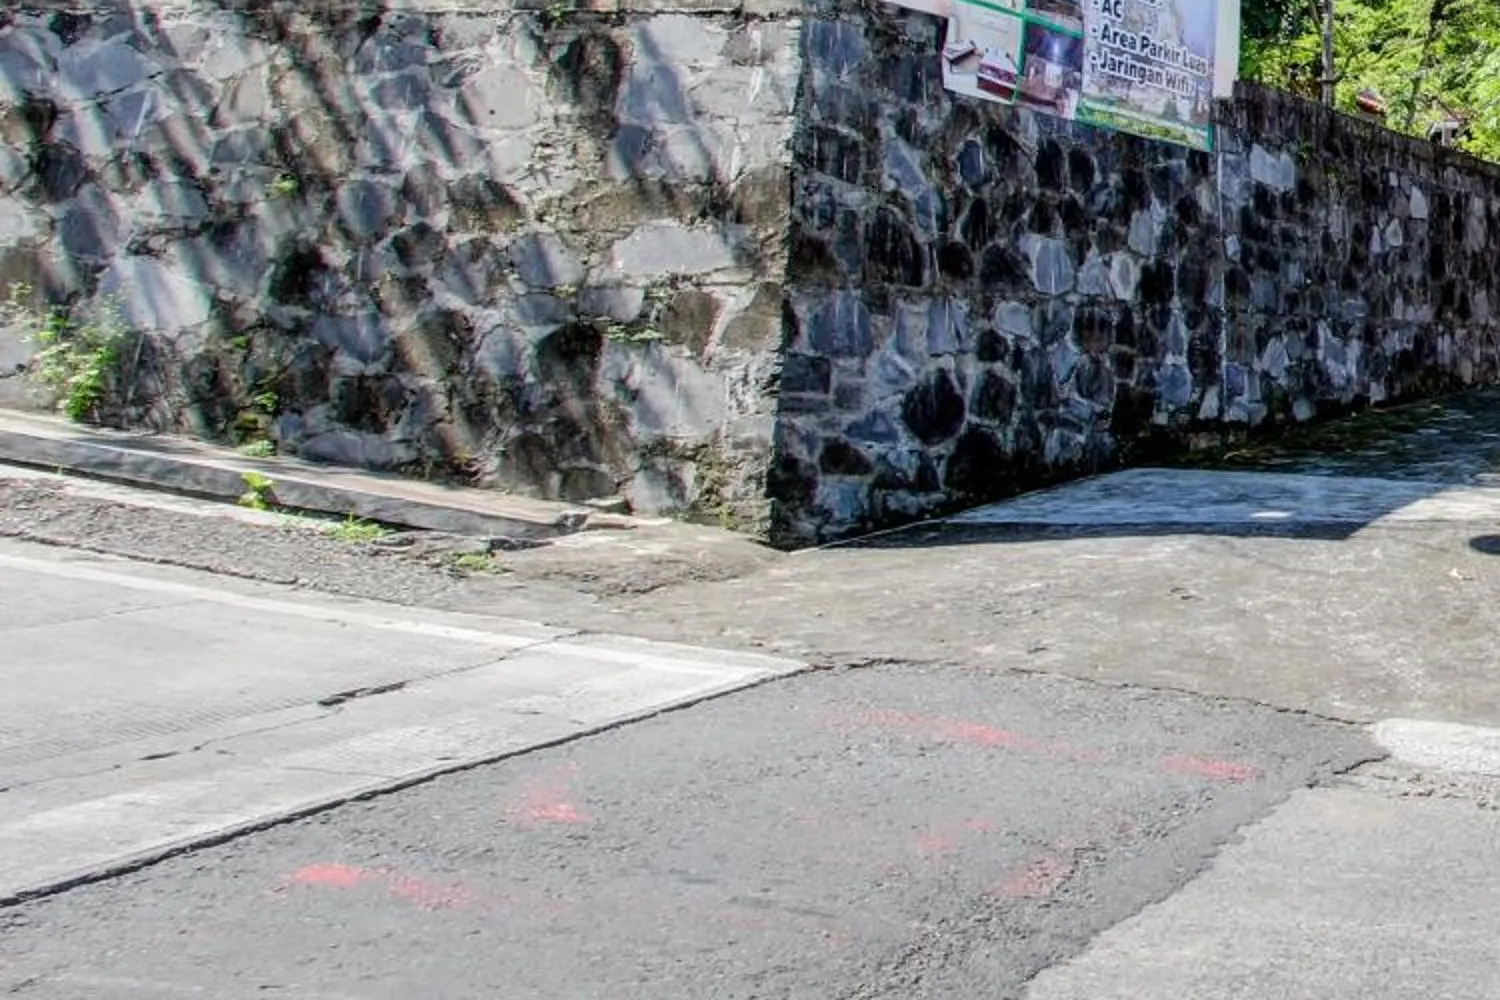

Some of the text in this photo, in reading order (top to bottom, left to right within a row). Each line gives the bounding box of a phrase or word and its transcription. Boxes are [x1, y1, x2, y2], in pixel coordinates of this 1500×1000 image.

[1100, 50, 1162, 84] Jaringan
[1101, 23, 1207, 75] Area Parkir Luas
